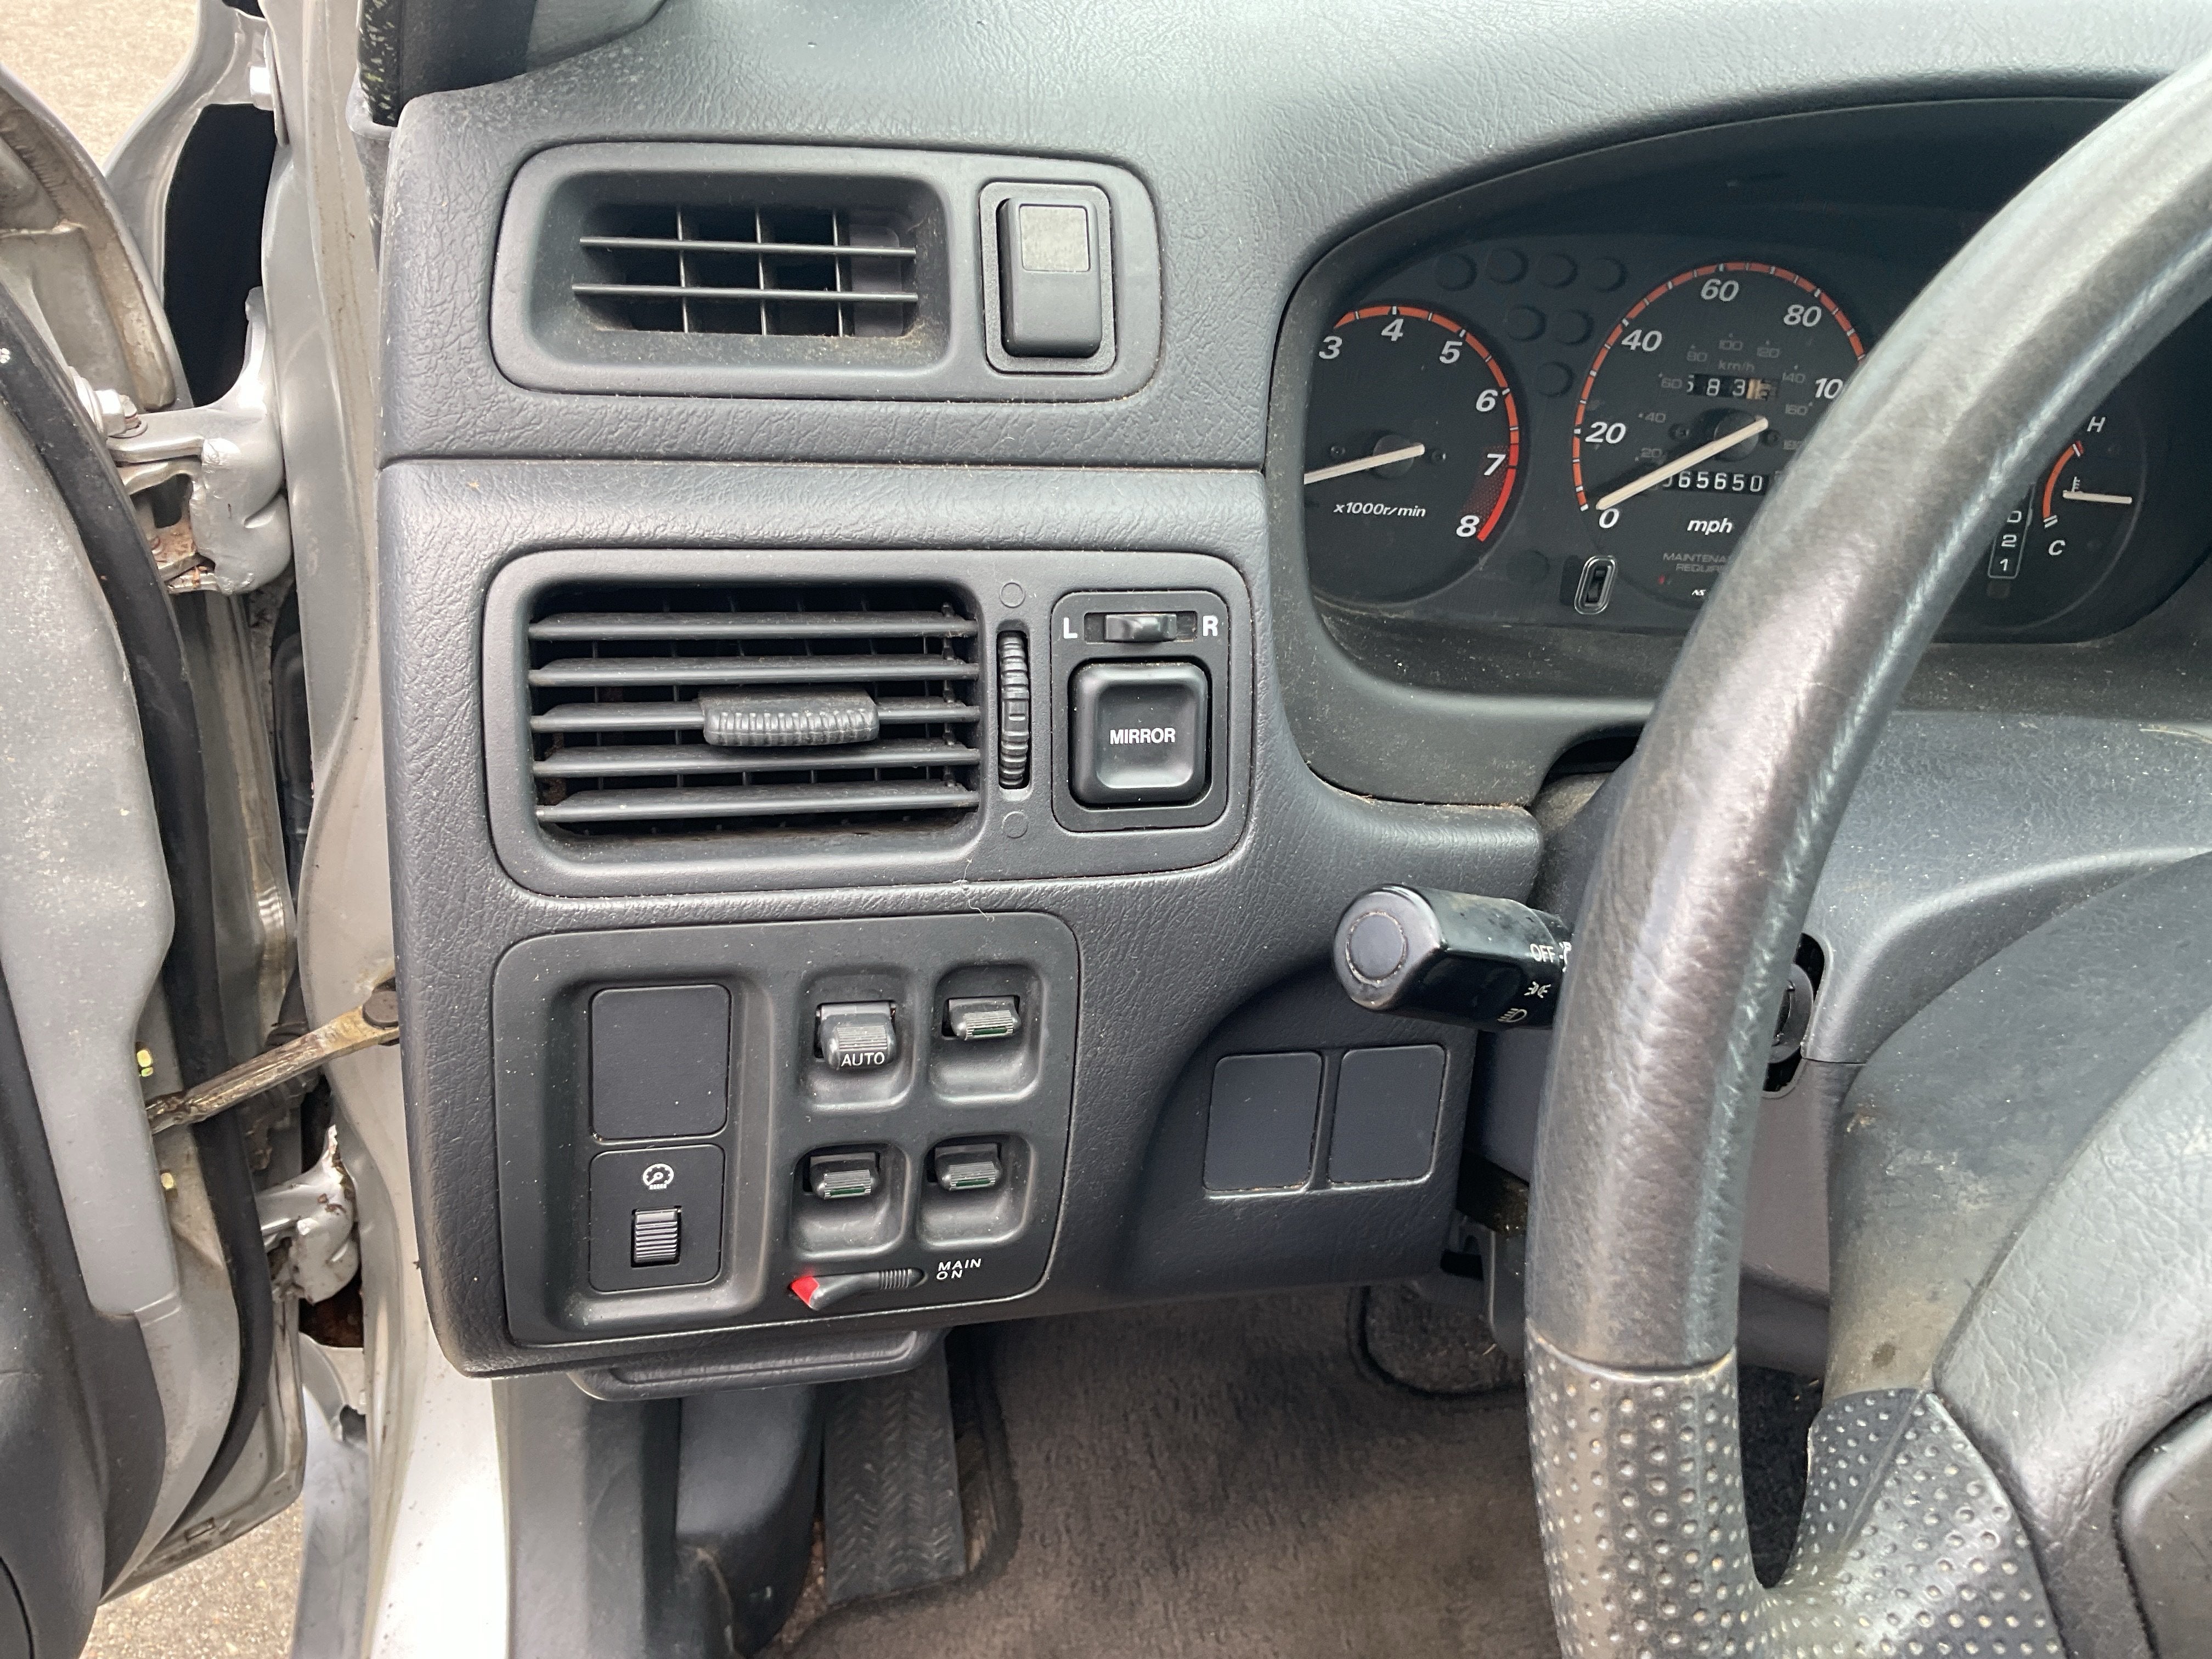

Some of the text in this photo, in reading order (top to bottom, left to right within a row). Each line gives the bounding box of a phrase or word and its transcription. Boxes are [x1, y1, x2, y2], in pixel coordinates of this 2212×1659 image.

[1701, 279, 1740, 302] 60
[1784, 304, 1822, 327] 80
[1381, 319, 1404, 341] 4
[1319, 336, 1343, 360] 3
[1622, 329, 1662, 352] 40
[1439, 340, 1463, 364] 5
[1815, 377, 1843, 399] 10
[1476, 389, 1498, 413] 6
[1585, 422, 1626, 444] 20
[2086, 416, 2106, 433] H
[1484, 453, 1506, 476] 7
[1333, 502, 1426, 518] x1000r/min
[1599, 508, 1620, 529] 0
[2007, 510, 2022, 523] D
[1455, 515, 1480, 538] 8
[1687, 517, 1733, 535] mph
[2001, 534, 2017, 548] 2
[2048, 540, 2066, 556] C
[1663, 552, 1727, 563] MAINTENA
[2000, 557, 2009, 571] 1
[1063, 615, 1219, 640] L R
[1109, 727, 1176, 745] MIRROR
[1530, 943, 1555, 963] OFF
[840, 1051, 886, 1068] AUTO
[935, 1269, 964, 1281] ON
[937, 1258, 982, 1272] MAIN
